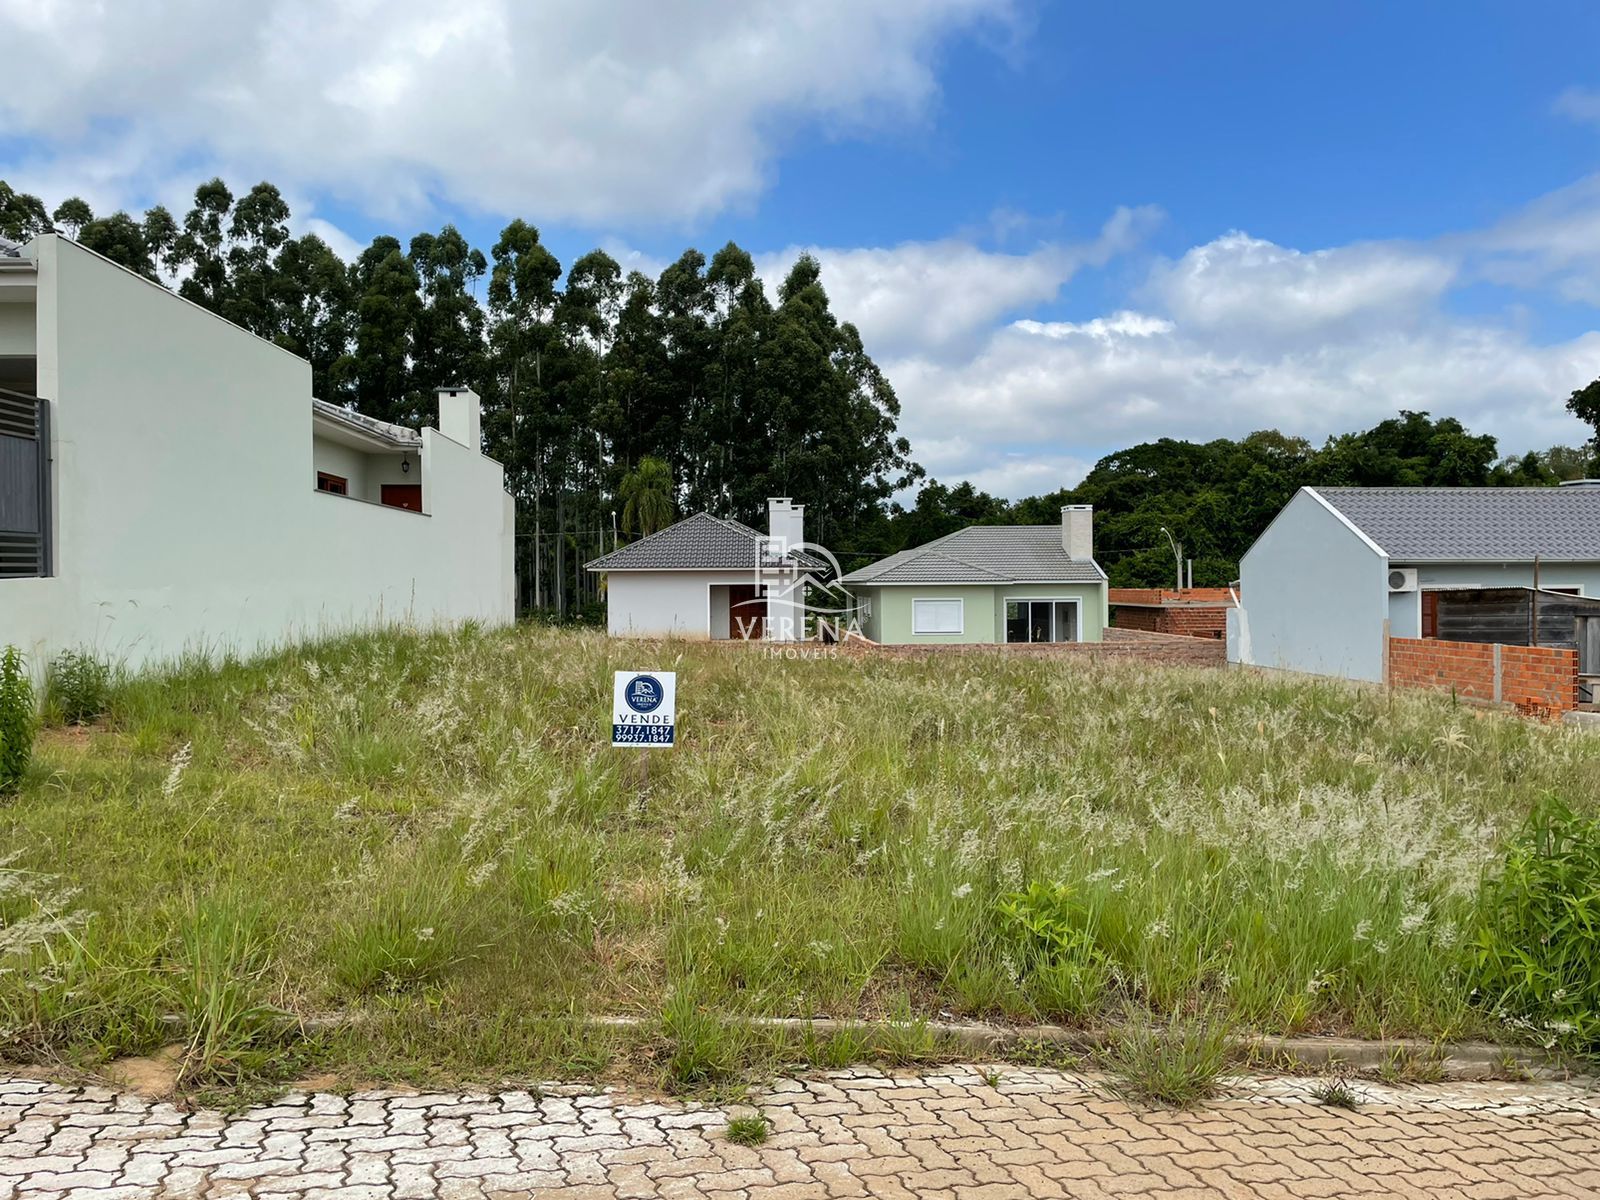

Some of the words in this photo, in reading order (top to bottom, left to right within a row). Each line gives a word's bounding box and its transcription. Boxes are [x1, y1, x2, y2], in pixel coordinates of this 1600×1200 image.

[619, 714, 670, 724] VENDE
[616, 725, 670, 735] 3717.1847
[615, 734, 670, 742] 99937.1847
